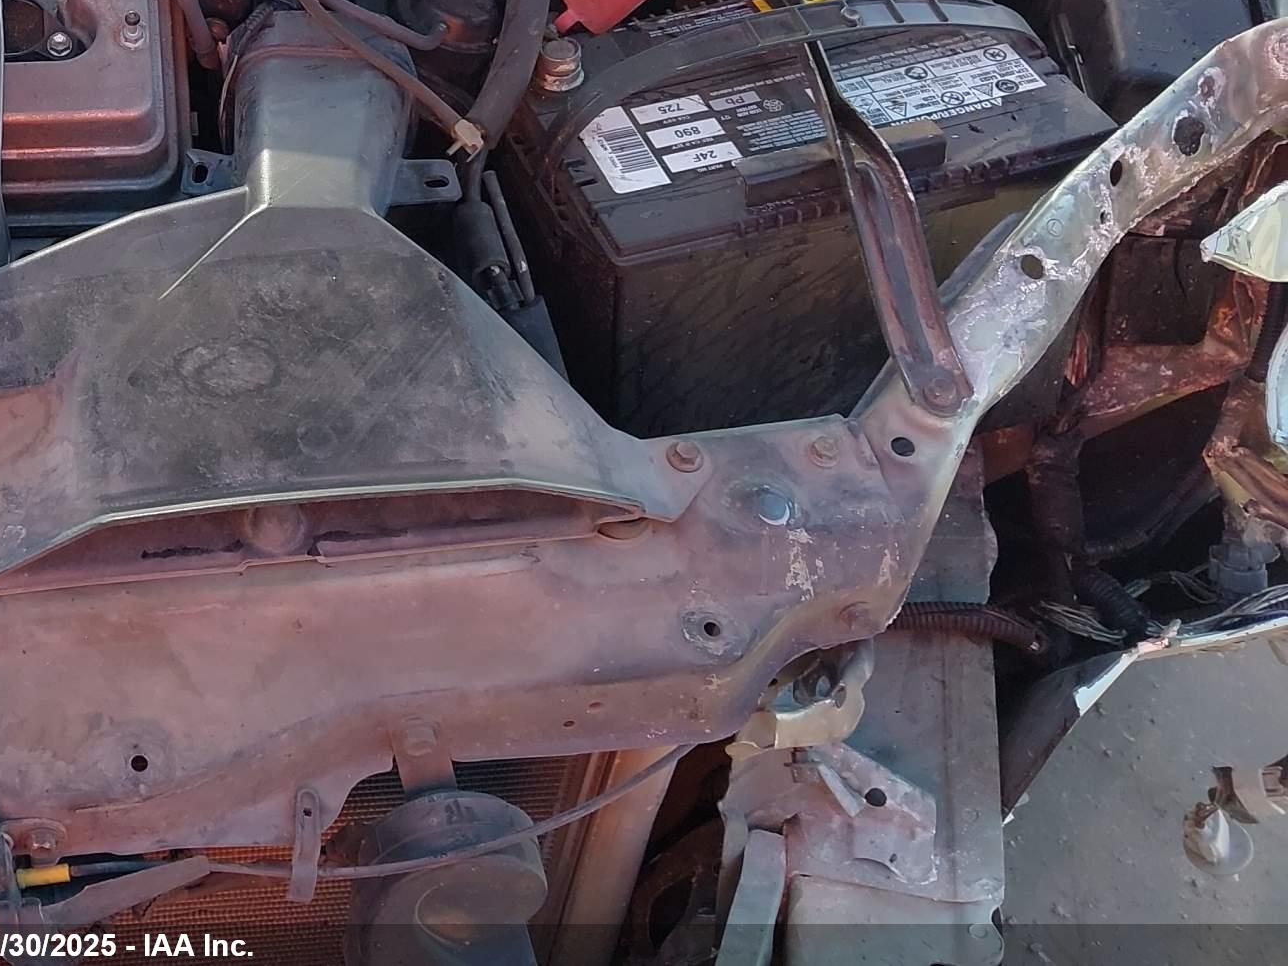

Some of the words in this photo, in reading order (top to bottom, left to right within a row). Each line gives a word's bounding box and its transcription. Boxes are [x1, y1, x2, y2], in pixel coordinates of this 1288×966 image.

[725, 96, 745, 106] Pb
[657, 102, 684, 115] 725
[673, 126, 701, 139] 890
[692, 149, 718, 163] 24F
